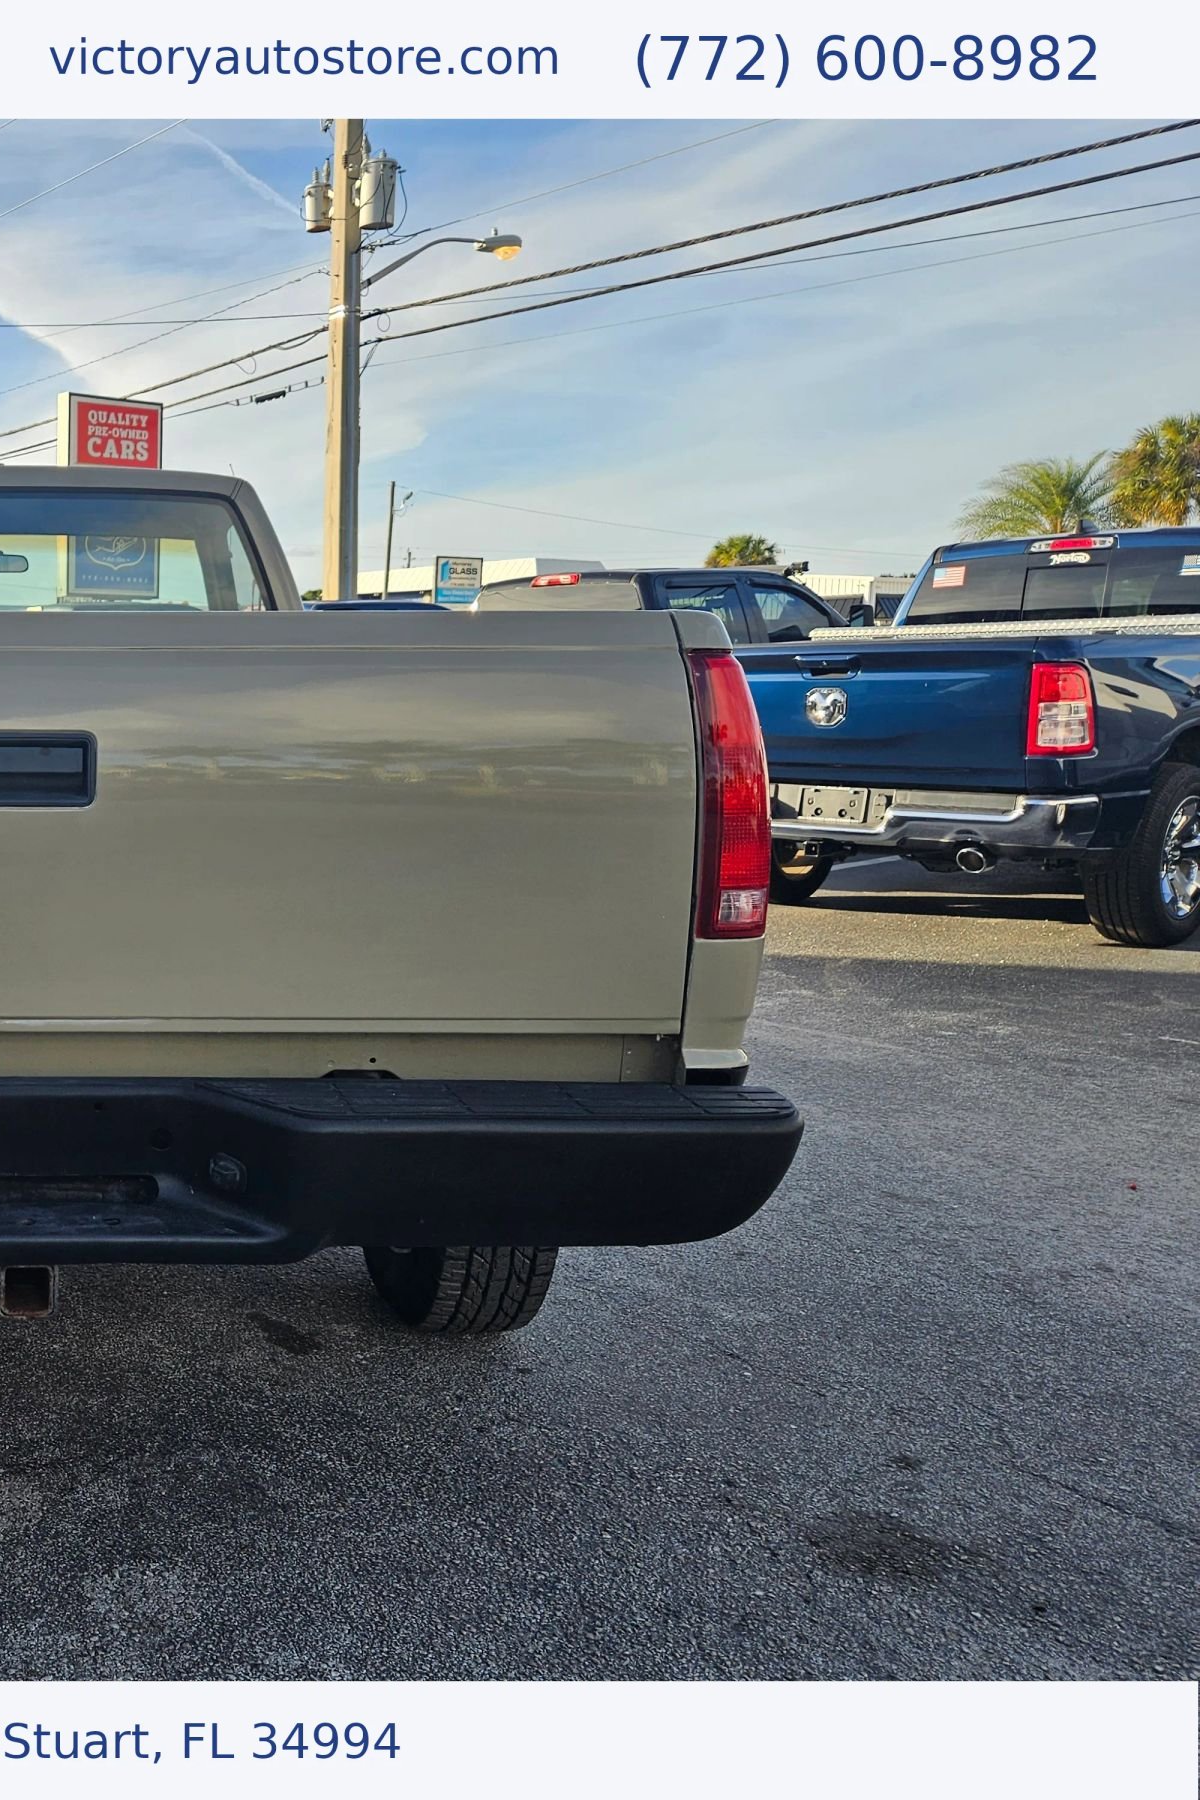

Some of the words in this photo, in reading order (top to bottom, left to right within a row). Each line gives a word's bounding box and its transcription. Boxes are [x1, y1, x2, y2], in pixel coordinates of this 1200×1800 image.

[87, 409, 149, 428] QUALITY
[87, 424, 149, 440] PRE-OWNED
[86, 436, 149, 462] CARS
[1049, 551, 1091, 566] Norton
[448, 567, 478, 575] GLASS
